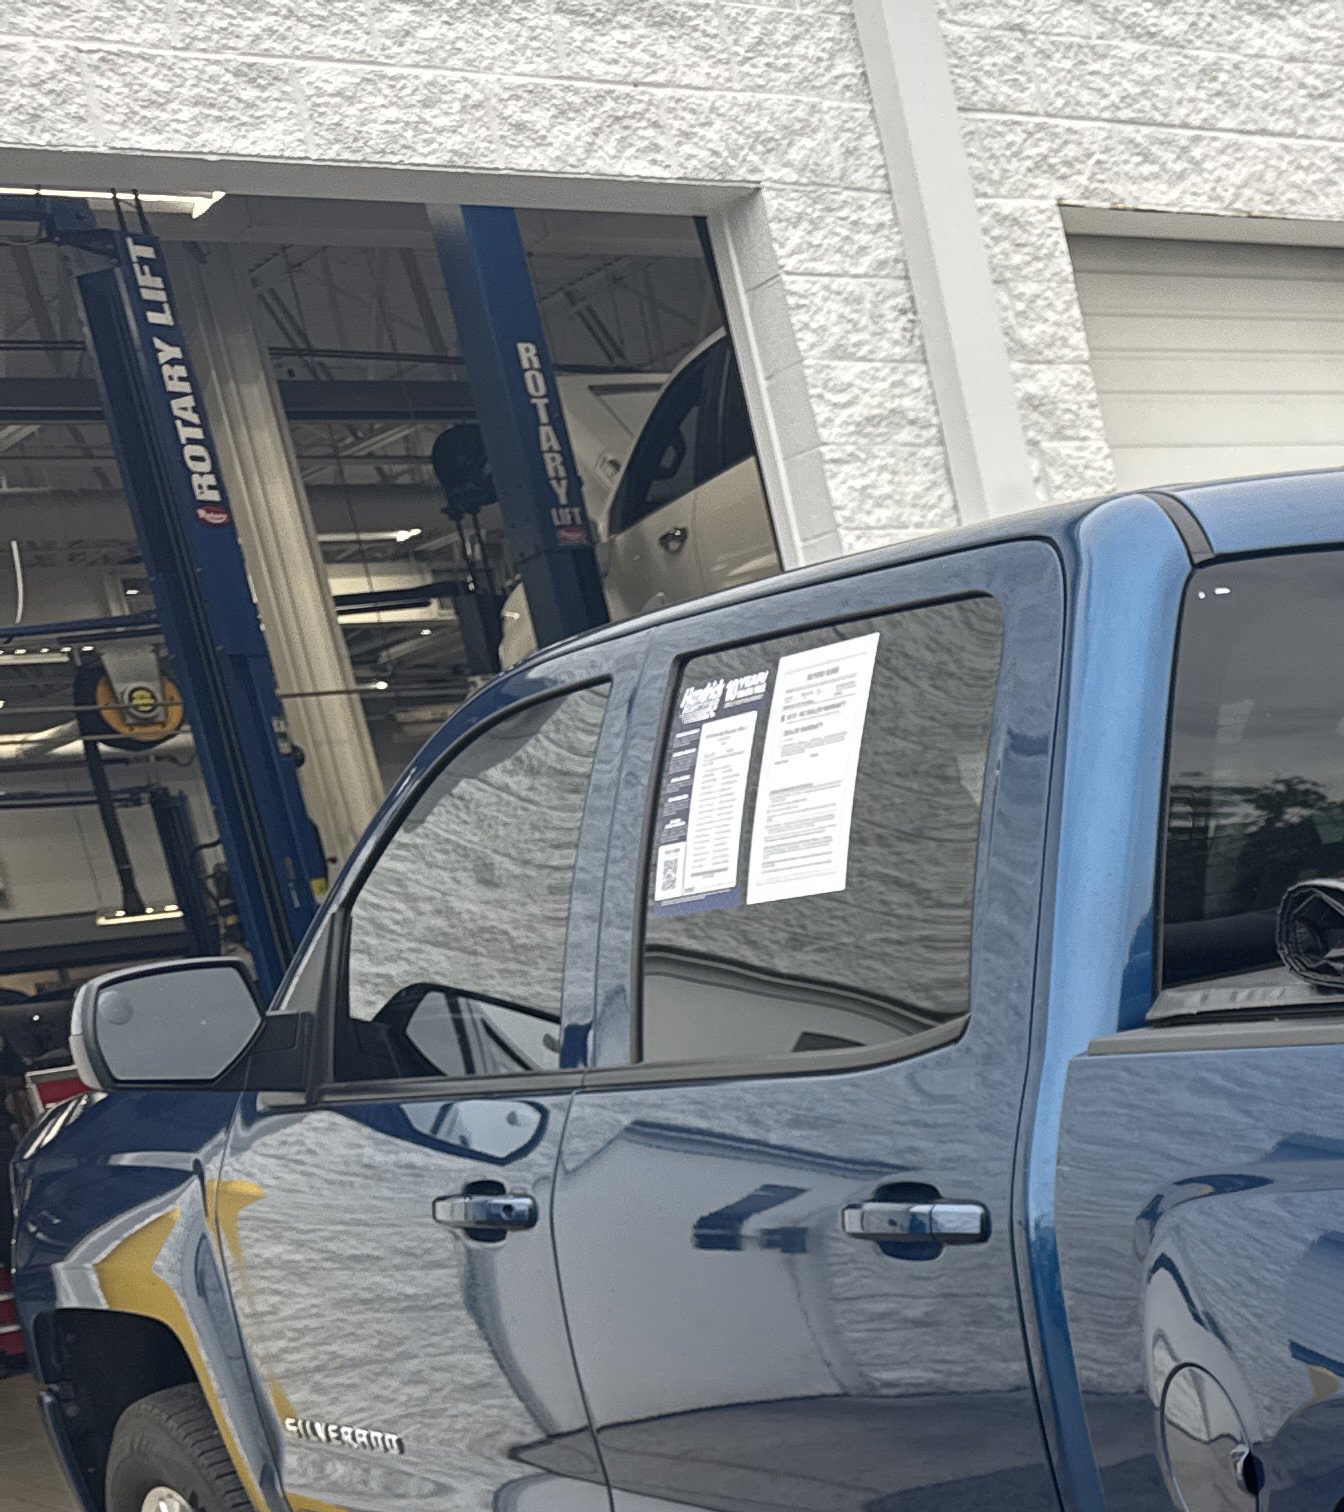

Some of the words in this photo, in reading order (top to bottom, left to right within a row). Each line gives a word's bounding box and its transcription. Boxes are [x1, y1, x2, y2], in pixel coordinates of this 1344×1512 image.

[126, 236, 175, 326] LIFT
[153, 336, 221, 502] ROTARY
[516, 342, 568, 505] ROTARY
[551, 507, 583, 527] LIFT
[285, 1417, 404, 1454] SILVERADO
